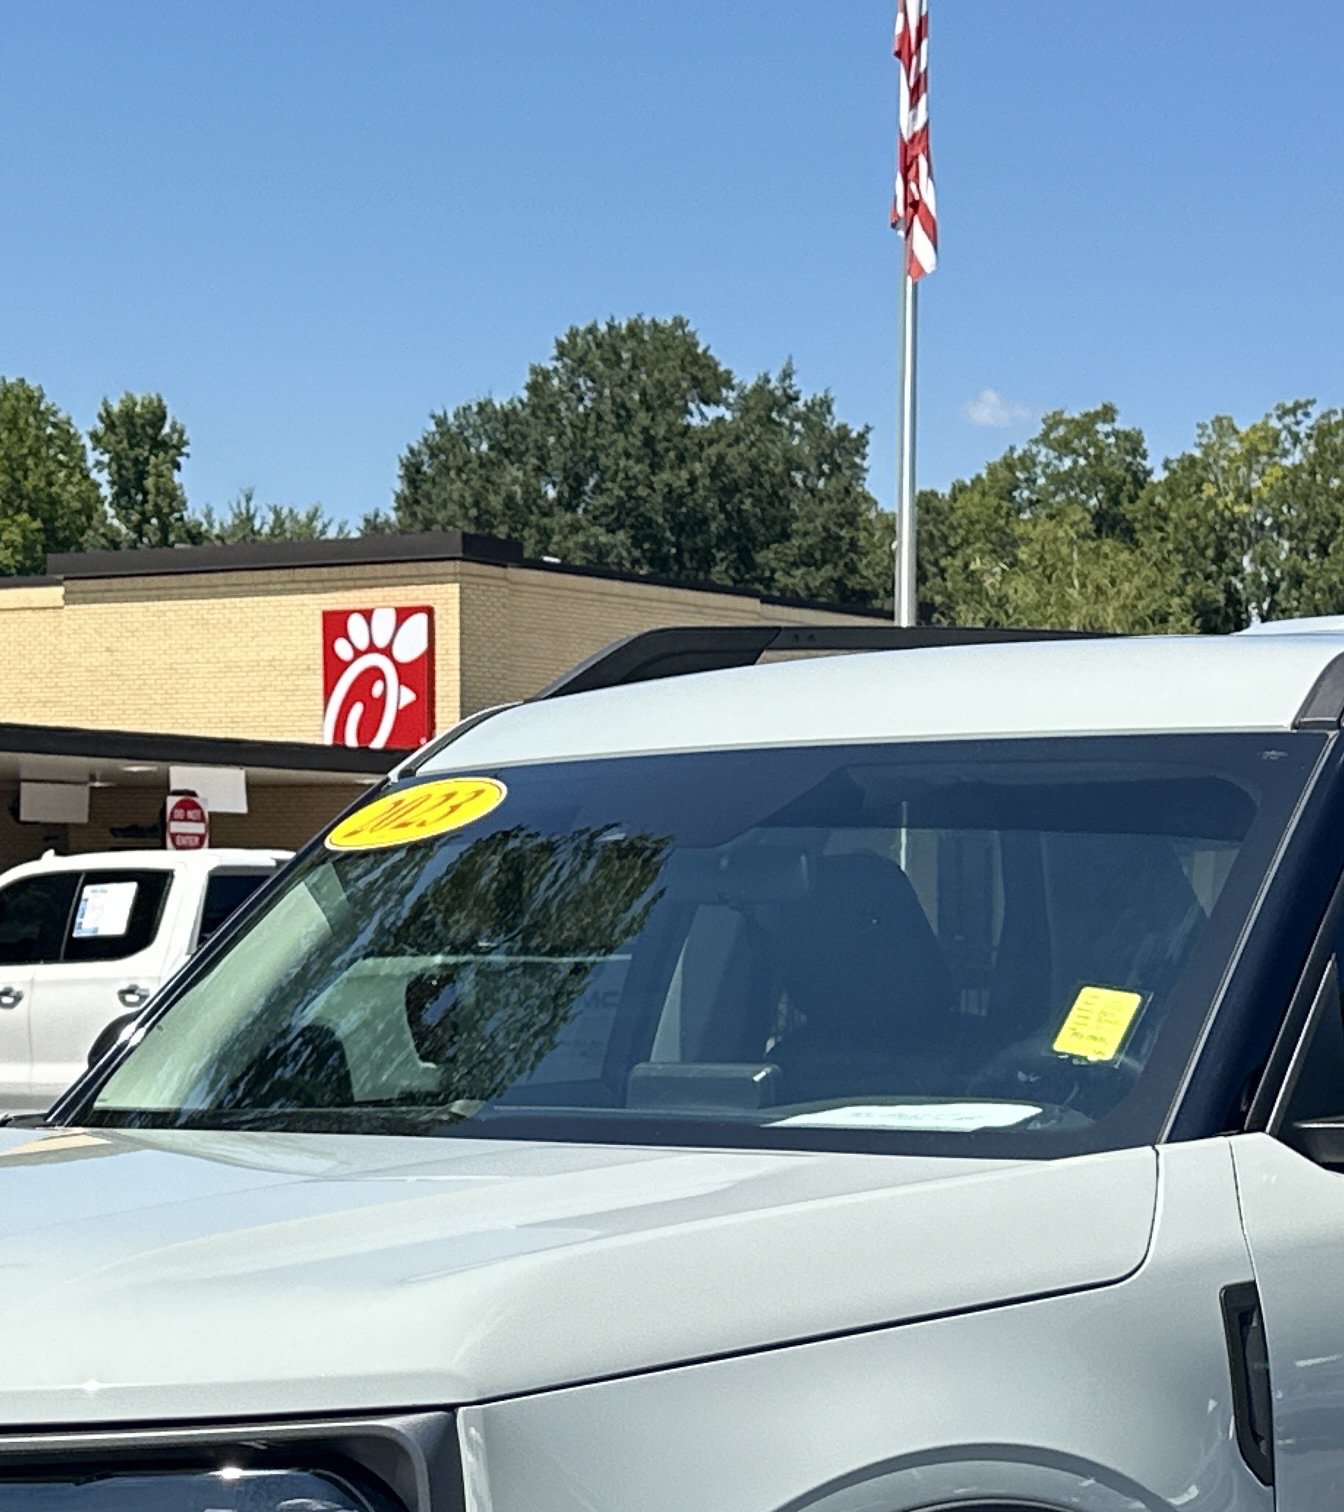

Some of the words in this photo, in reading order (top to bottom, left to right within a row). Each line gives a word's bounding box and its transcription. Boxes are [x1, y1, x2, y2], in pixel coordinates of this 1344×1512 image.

[173, 809, 185, 820] DO
[187, 809, 201, 820] NOT
[342, 788, 486, 838] 2023
